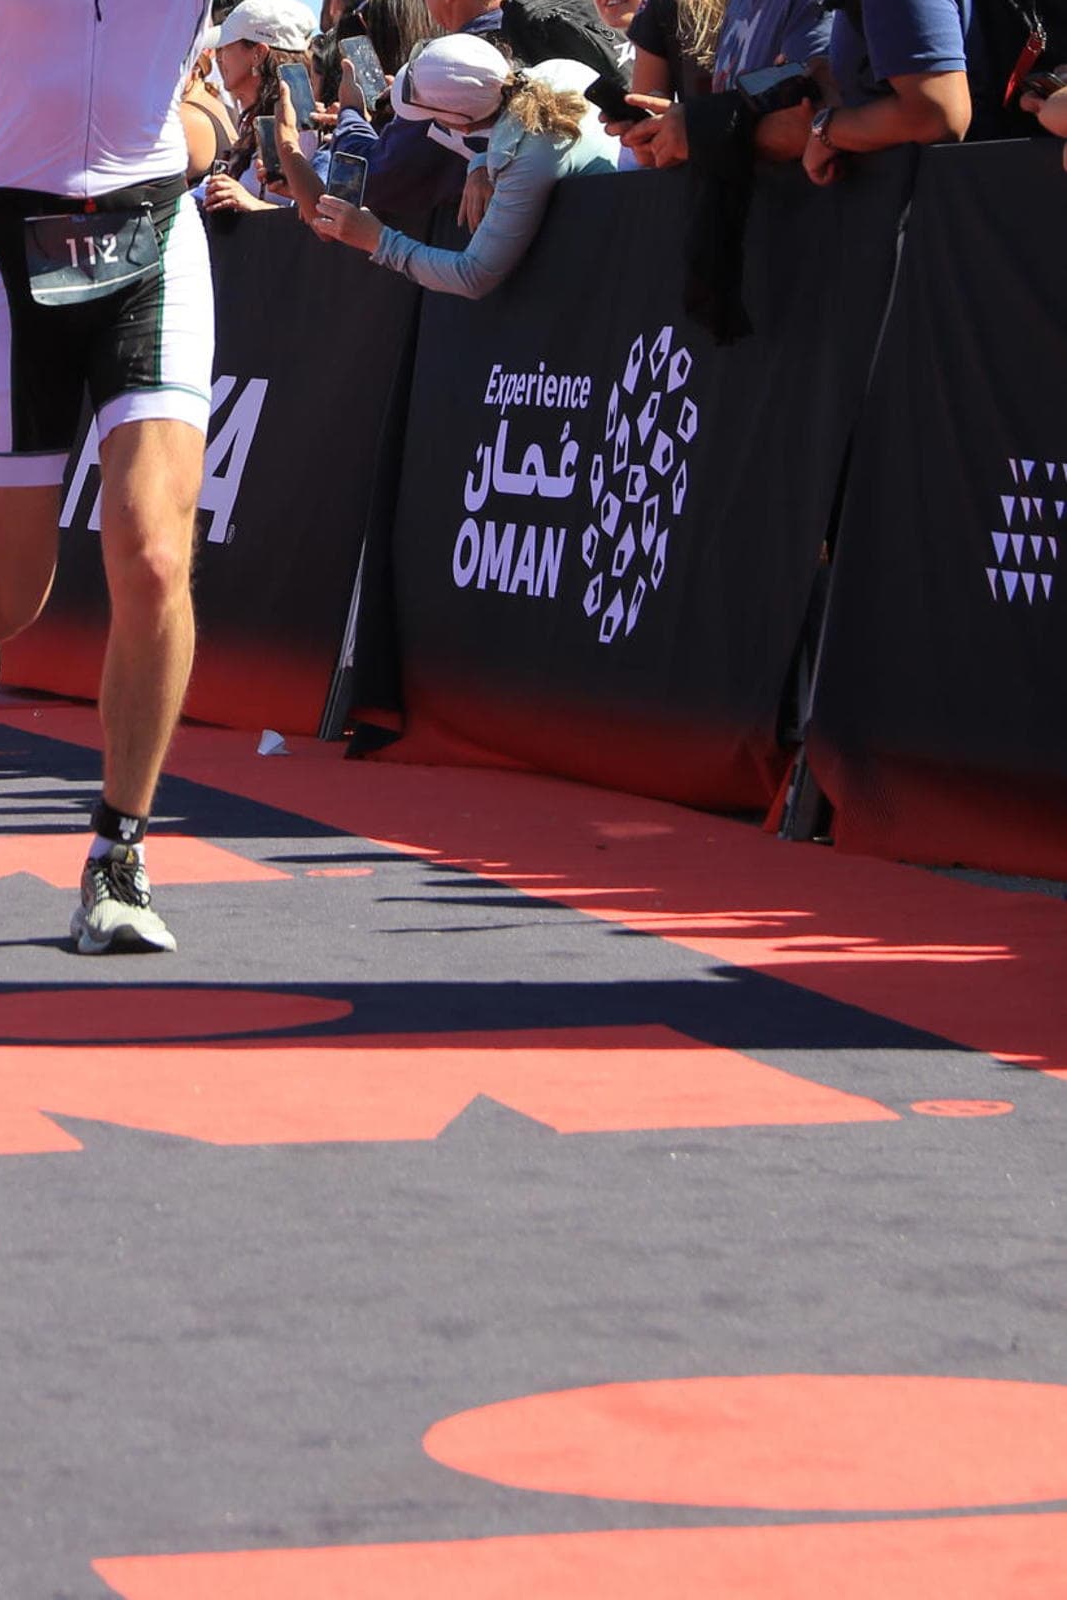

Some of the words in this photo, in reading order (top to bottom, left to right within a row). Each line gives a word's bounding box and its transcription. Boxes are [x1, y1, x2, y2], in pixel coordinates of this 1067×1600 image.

[65, 233, 119, 268] 112
[484, 363, 592, 415] Experience
[452, 517, 567, 599] OMAN
